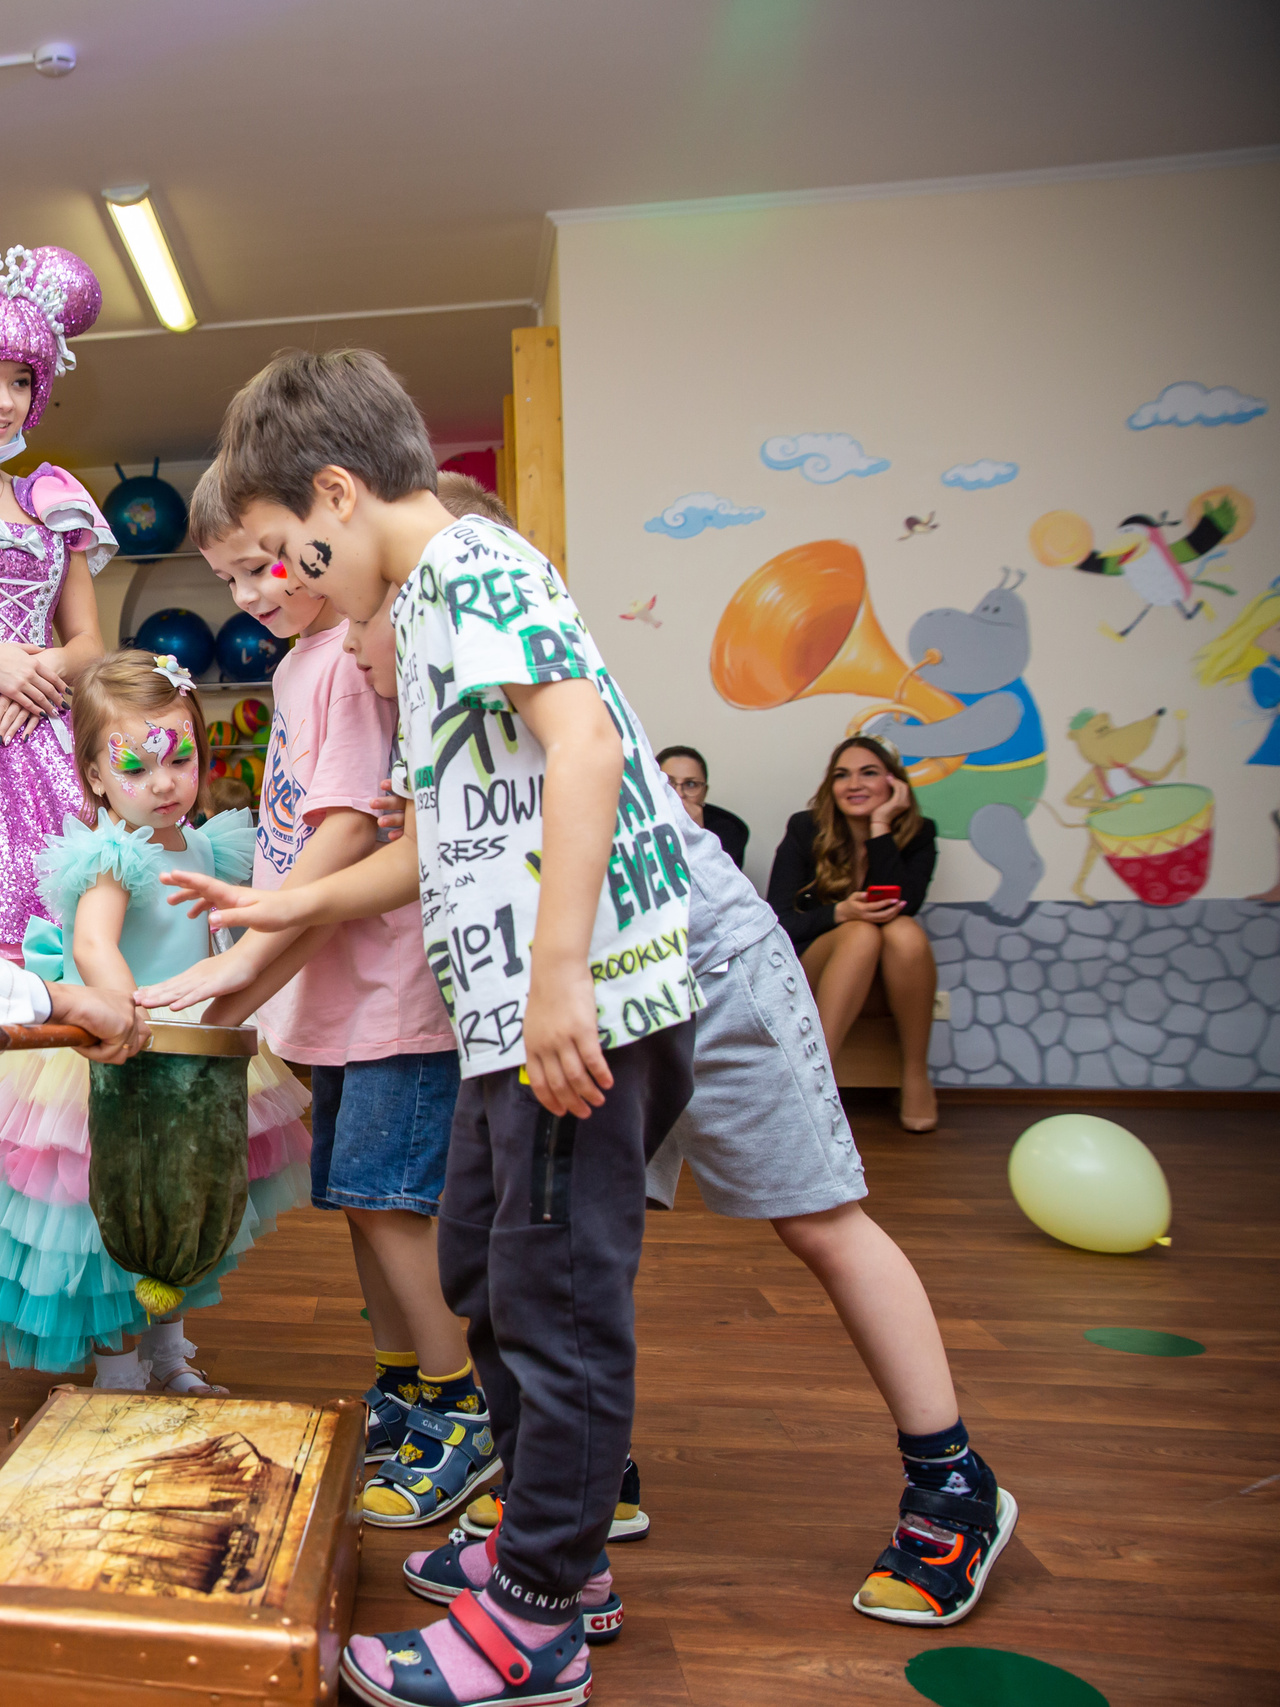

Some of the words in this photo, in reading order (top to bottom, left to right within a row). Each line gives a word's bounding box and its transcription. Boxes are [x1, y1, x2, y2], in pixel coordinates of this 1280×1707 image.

[463, 773, 544, 832] DOW
[613, 748, 656, 836] AY
[607, 822, 692, 932] EVER
[590, 927, 689, 984] ROOKLY
[622, 982, 682, 1039] ON
